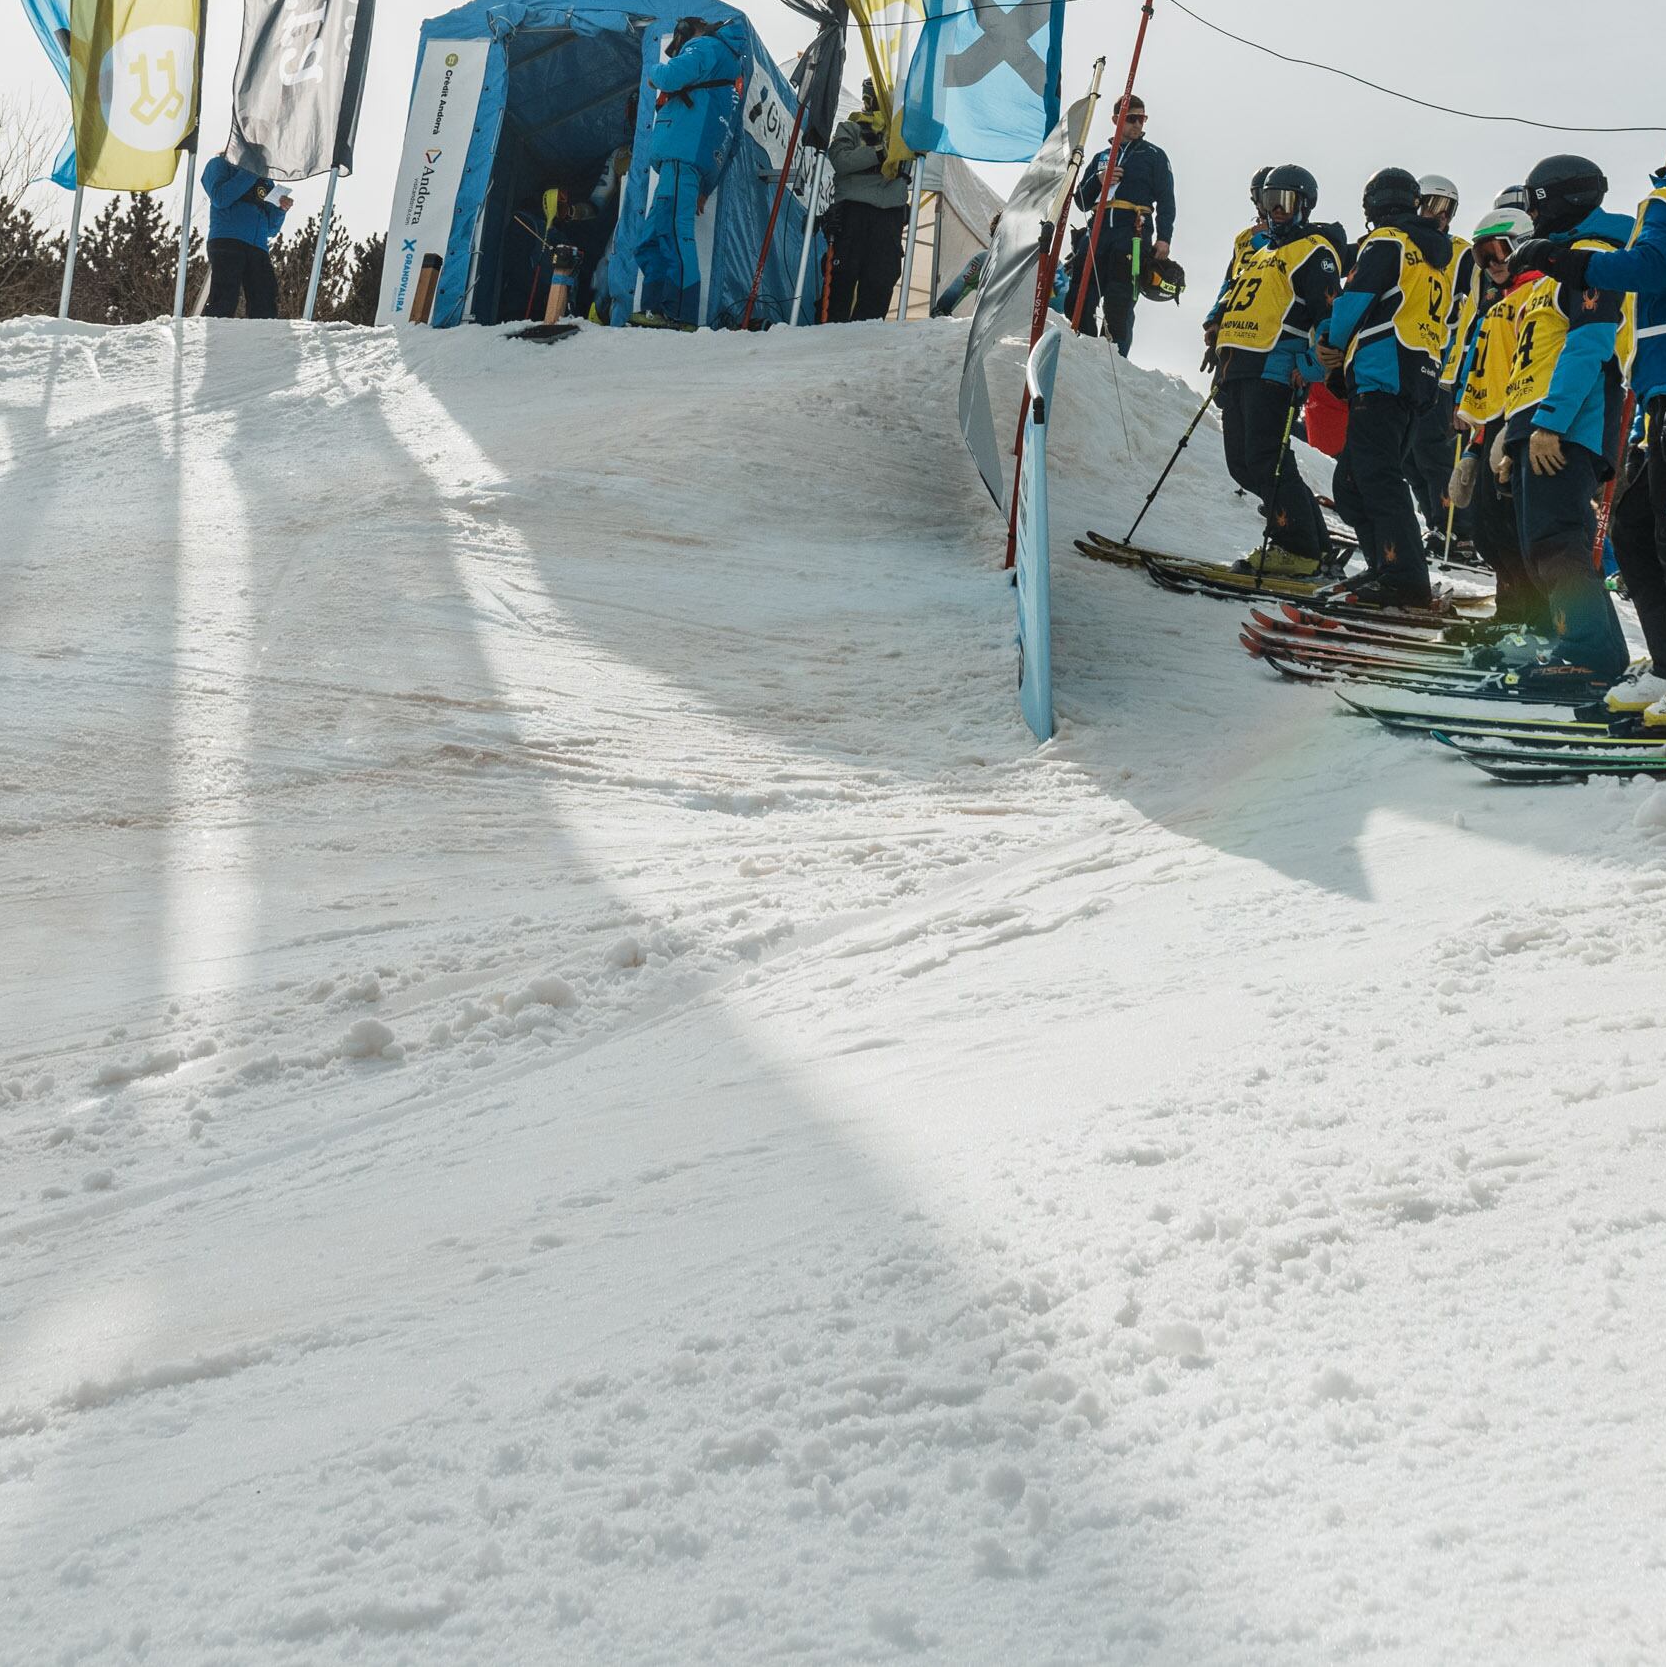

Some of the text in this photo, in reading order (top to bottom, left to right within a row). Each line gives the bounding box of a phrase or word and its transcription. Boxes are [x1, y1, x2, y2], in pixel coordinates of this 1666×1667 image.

[411, 166, 434, 225] Andorra
[396, 254, 413, 312] GRANDVALIRA
[963, 257, 981, 282] Audi
[1033, 281, 1042, 324] LISKI
